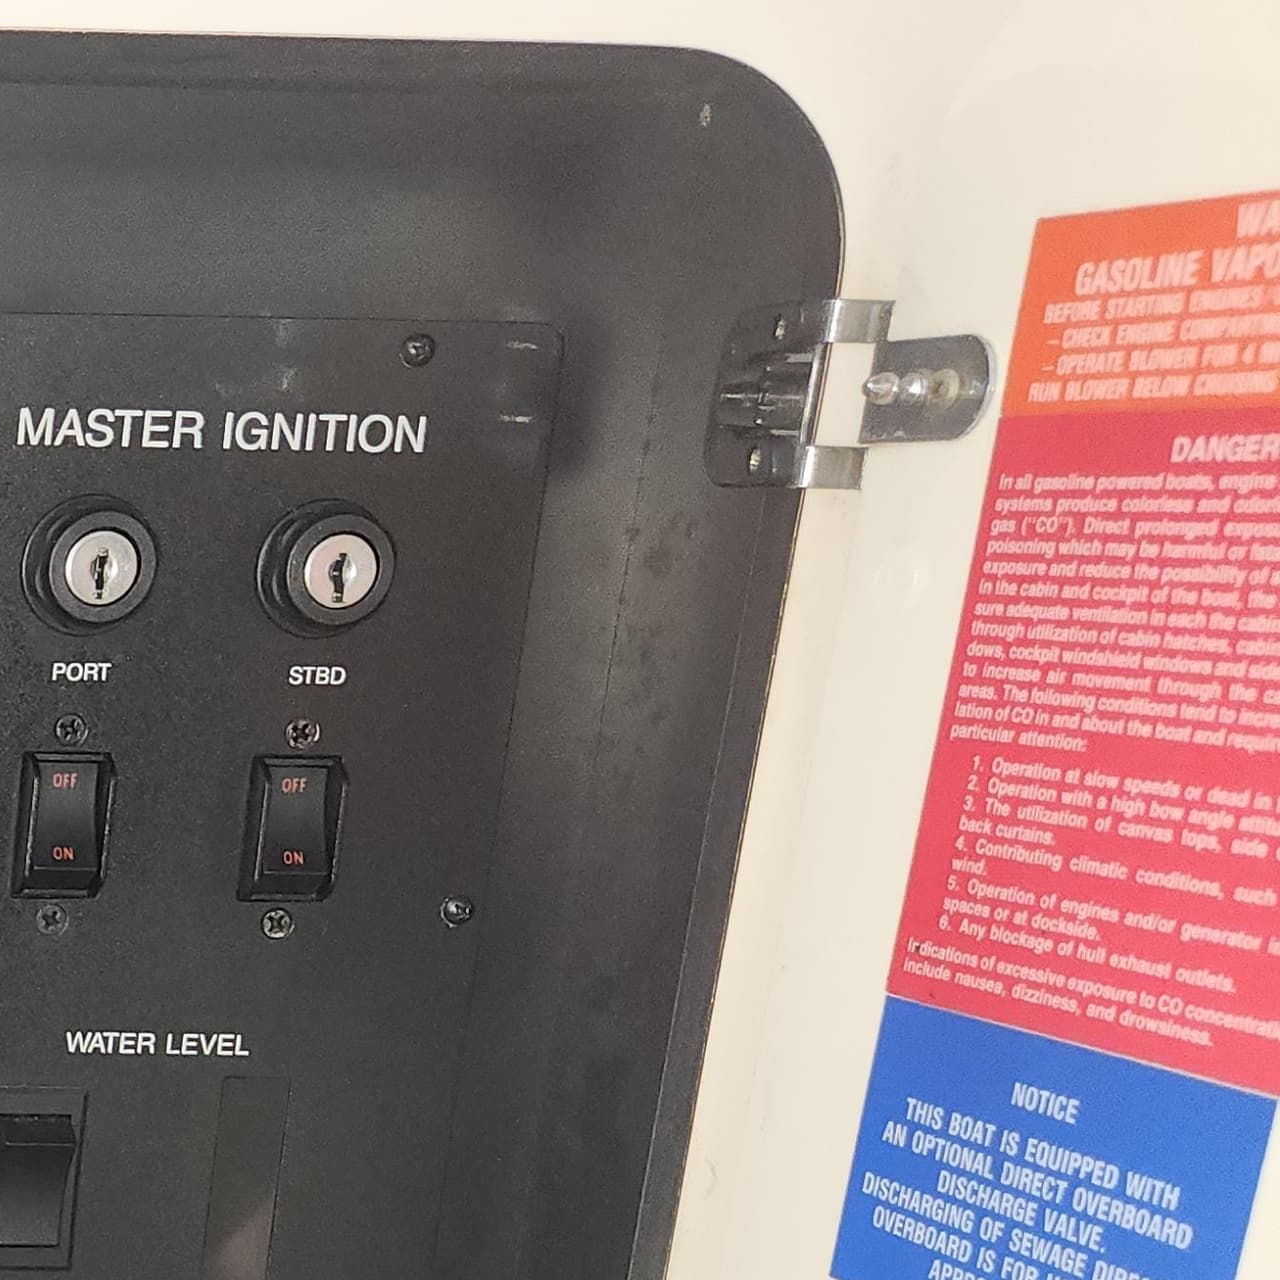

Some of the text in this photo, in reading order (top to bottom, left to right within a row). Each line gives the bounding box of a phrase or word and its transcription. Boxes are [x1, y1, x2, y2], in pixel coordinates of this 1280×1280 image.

[1075, 250, 1204, 297] GASOLINE
[17, 407, 426, 452] MASTER IGNITION
[52, 663, 112, 681] PORT
[289, 666, 345, 684] STBD
[53, 774, 76, 787] OFF
[54, 847, 73, 859] ON
[67, 1032, 249, 1055] WATER LEVEL
[1010, 1082, 1080, 1125] NOTICE
[905, 1097, 1181, 1211] THIS BOAT IS EQUIPPED WITH
[881, 1121, 1194, 1249] AN OPTIONAL DIRECT OVERBOARD
[862, 1171, 974, 1234] DISCHARGING
[979, 1216, 1004, 1242] OF
[1009, 1230, 1087, 1278] SEWAGE
[937, 1169, 1106, 1253] DISCHARGE VALVE.
[872, 1206, 971, 1264] OVERBOARD
[977, 1248, 996, 1273] IS
